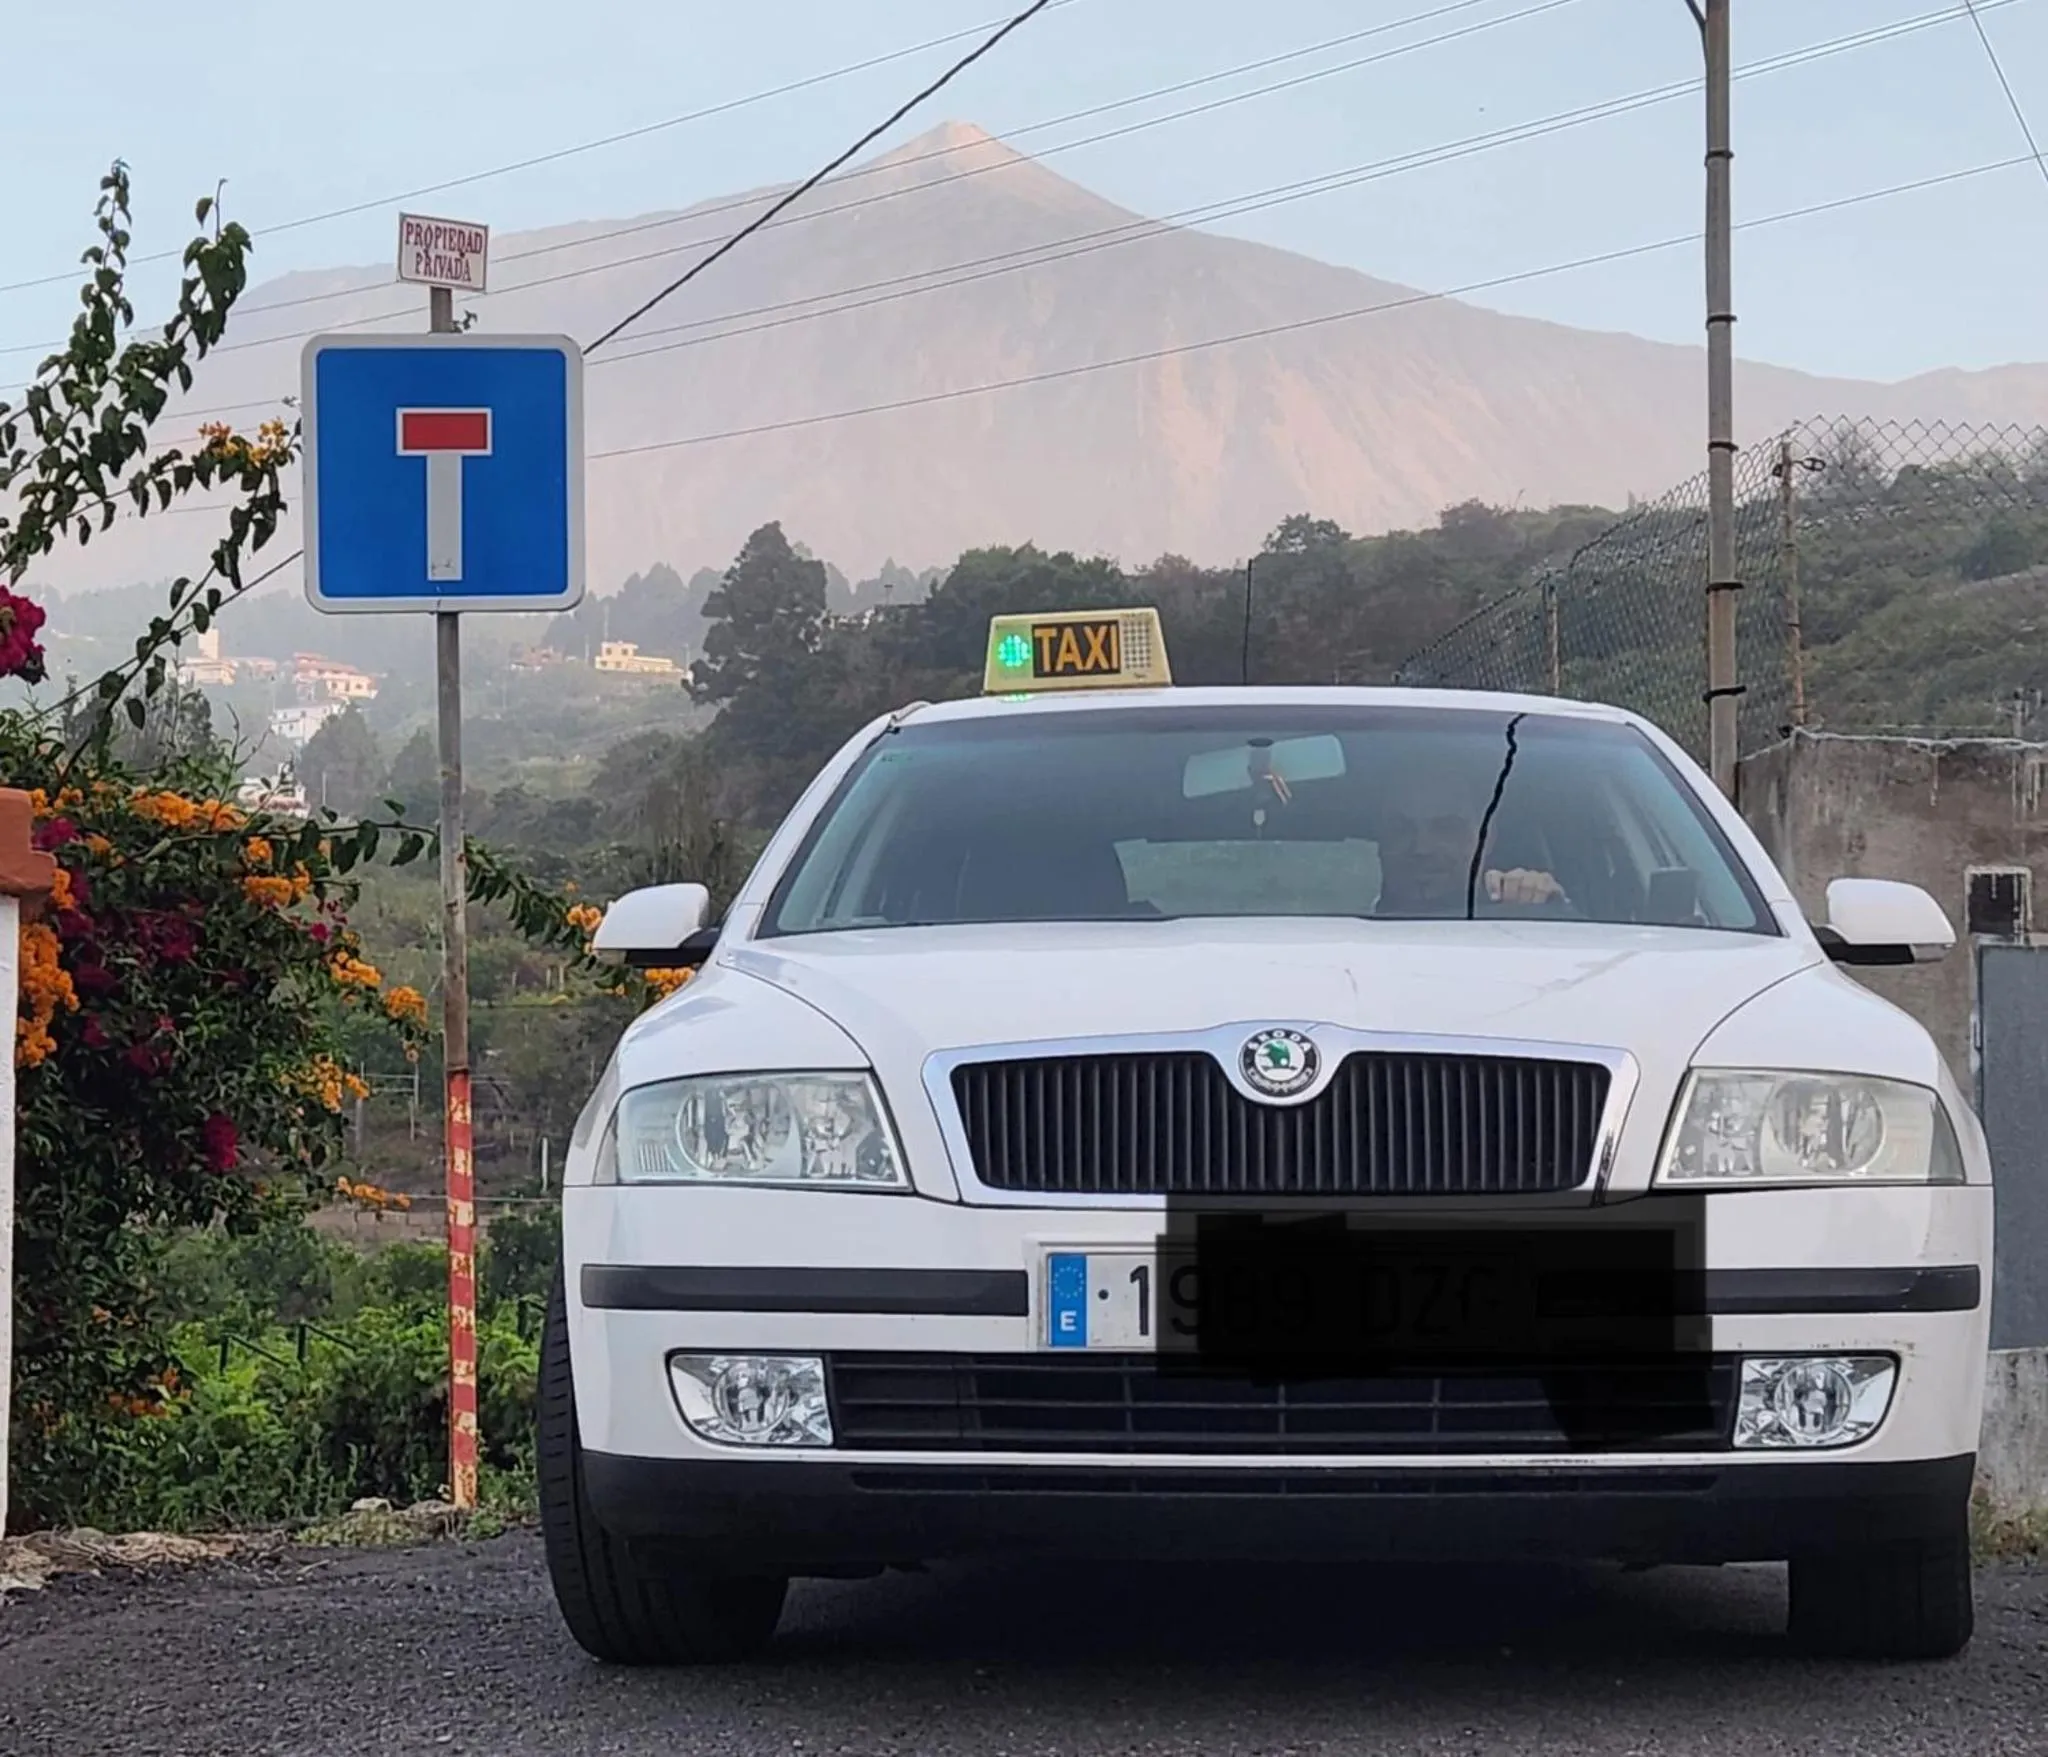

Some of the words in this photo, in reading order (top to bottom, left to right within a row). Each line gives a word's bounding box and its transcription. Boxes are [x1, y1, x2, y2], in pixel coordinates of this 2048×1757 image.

[405, 221, 483, 254] PROPIEDAD
[415, 251, 472, 282] PRIVADA
[1033, 624, 1119, 673] TAXI
[1060, 1310, 1077, 1331] E
